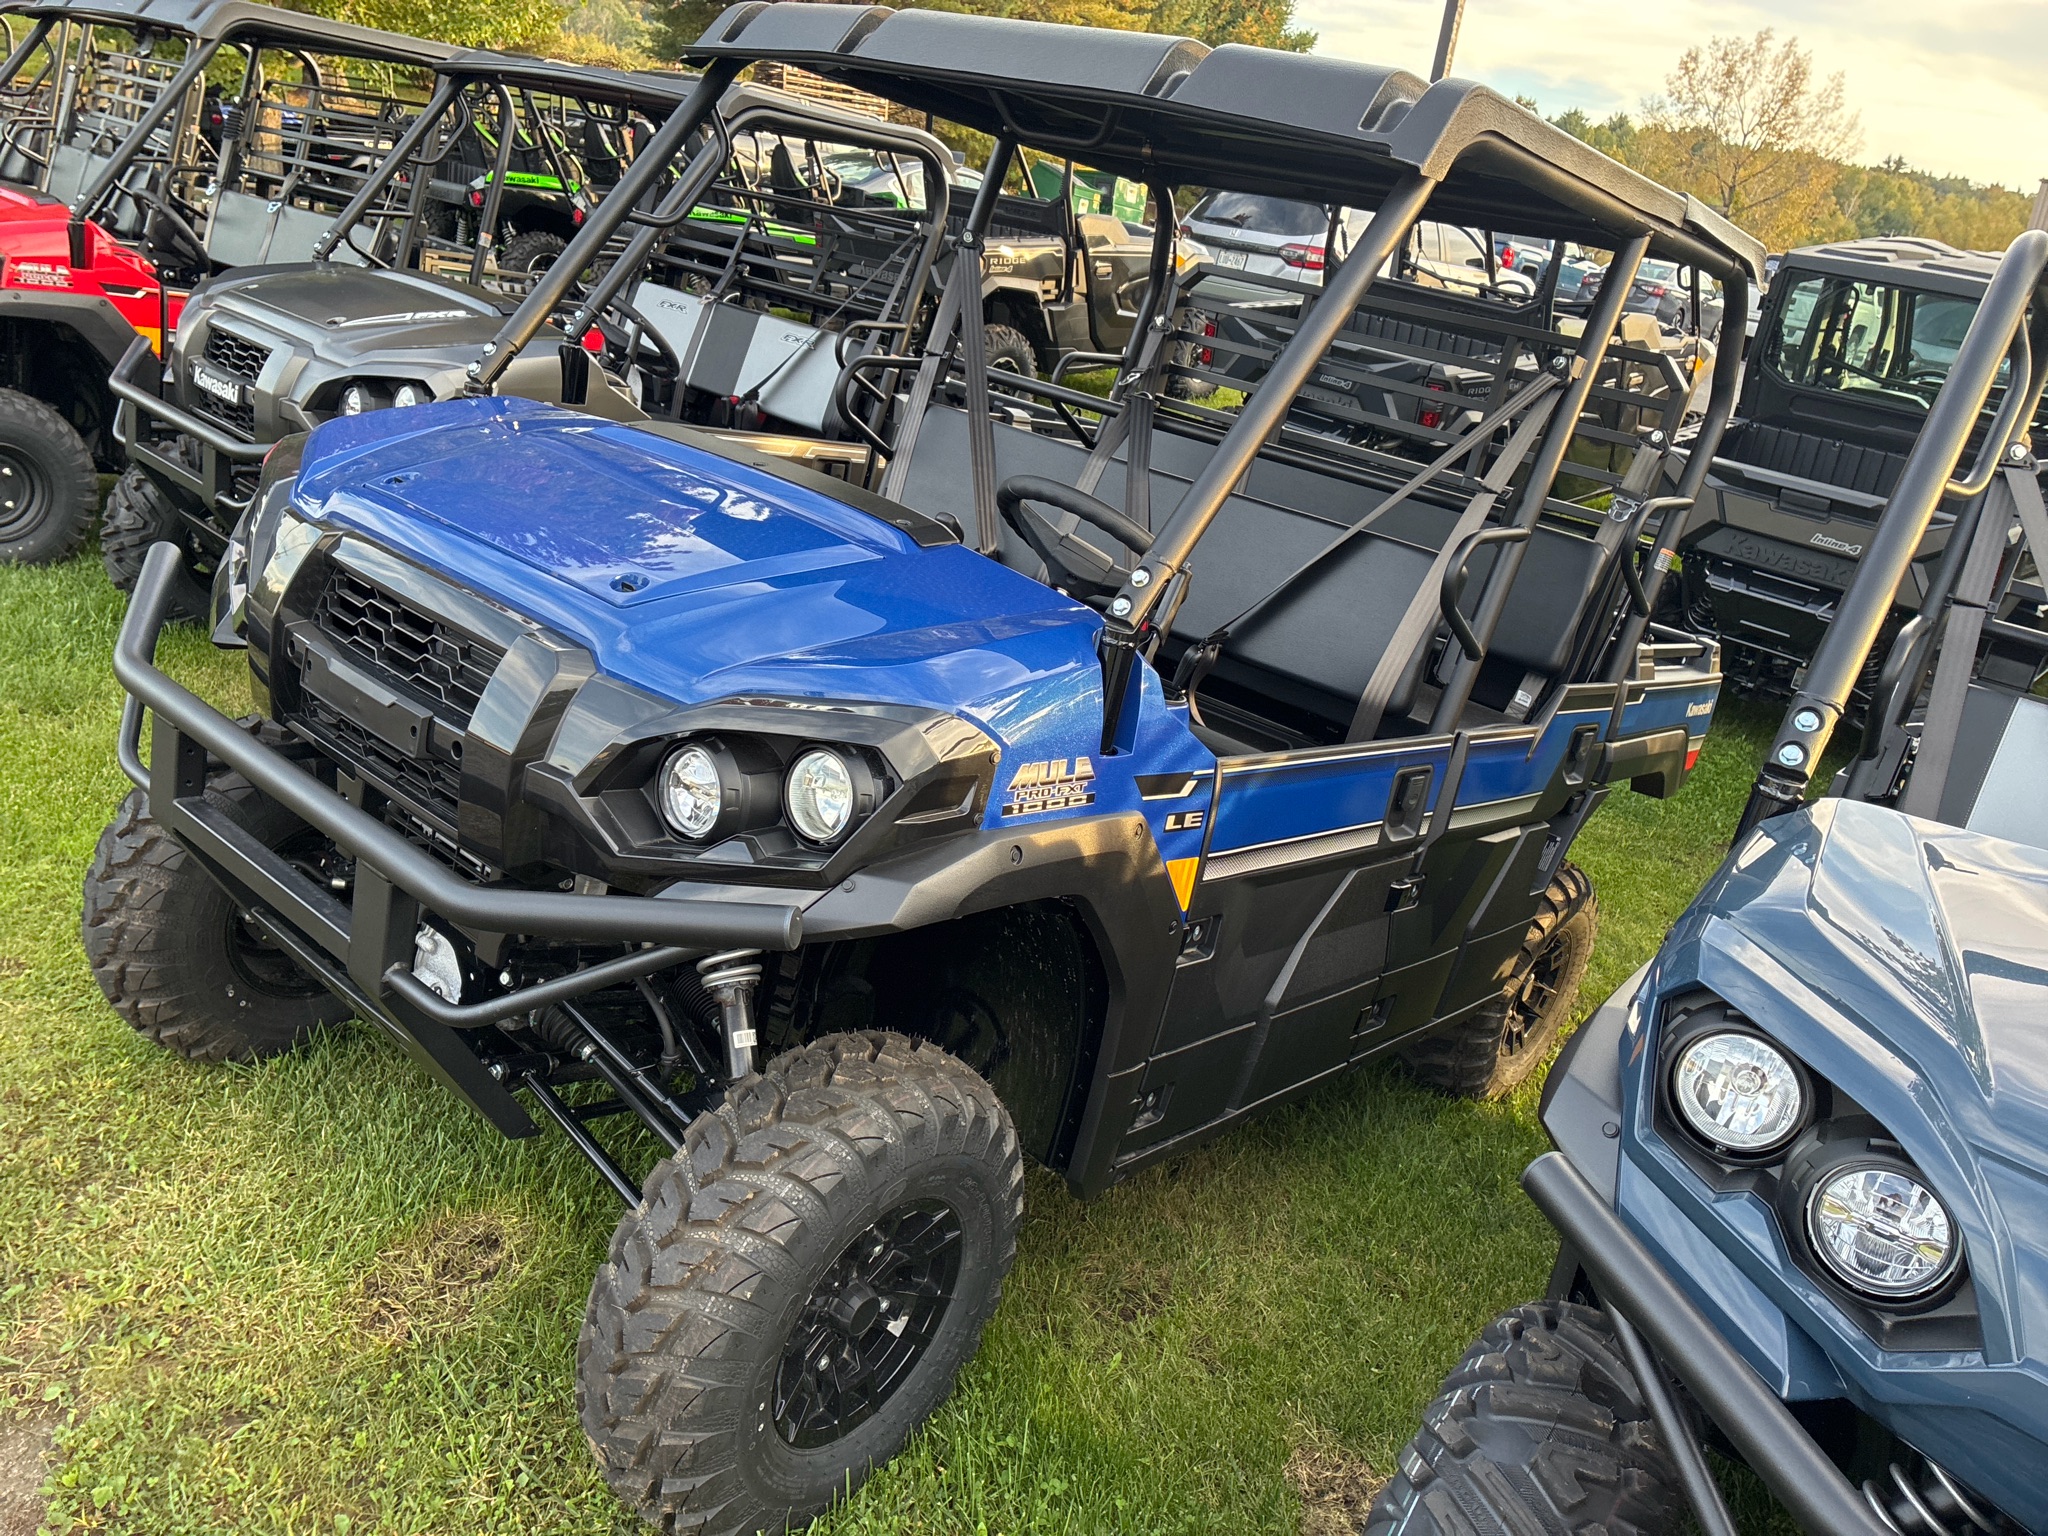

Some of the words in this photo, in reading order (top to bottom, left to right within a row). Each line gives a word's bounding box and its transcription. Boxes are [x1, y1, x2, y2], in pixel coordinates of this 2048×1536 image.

[989, 257, 1027, 265] RIDGE
[193, 365, 239, 404] Kawasaki
[1810, 532, 1862, 555] Inline-4
[1685, 699, 1714, 718] Kawasaki
[1007, 756, 1096, 792] MULE
[1014, 782, 1088, 803] PRO-FXT
[1011, 795, 1088, 815] 1000
[1165, 812, 1203, 831] LE
